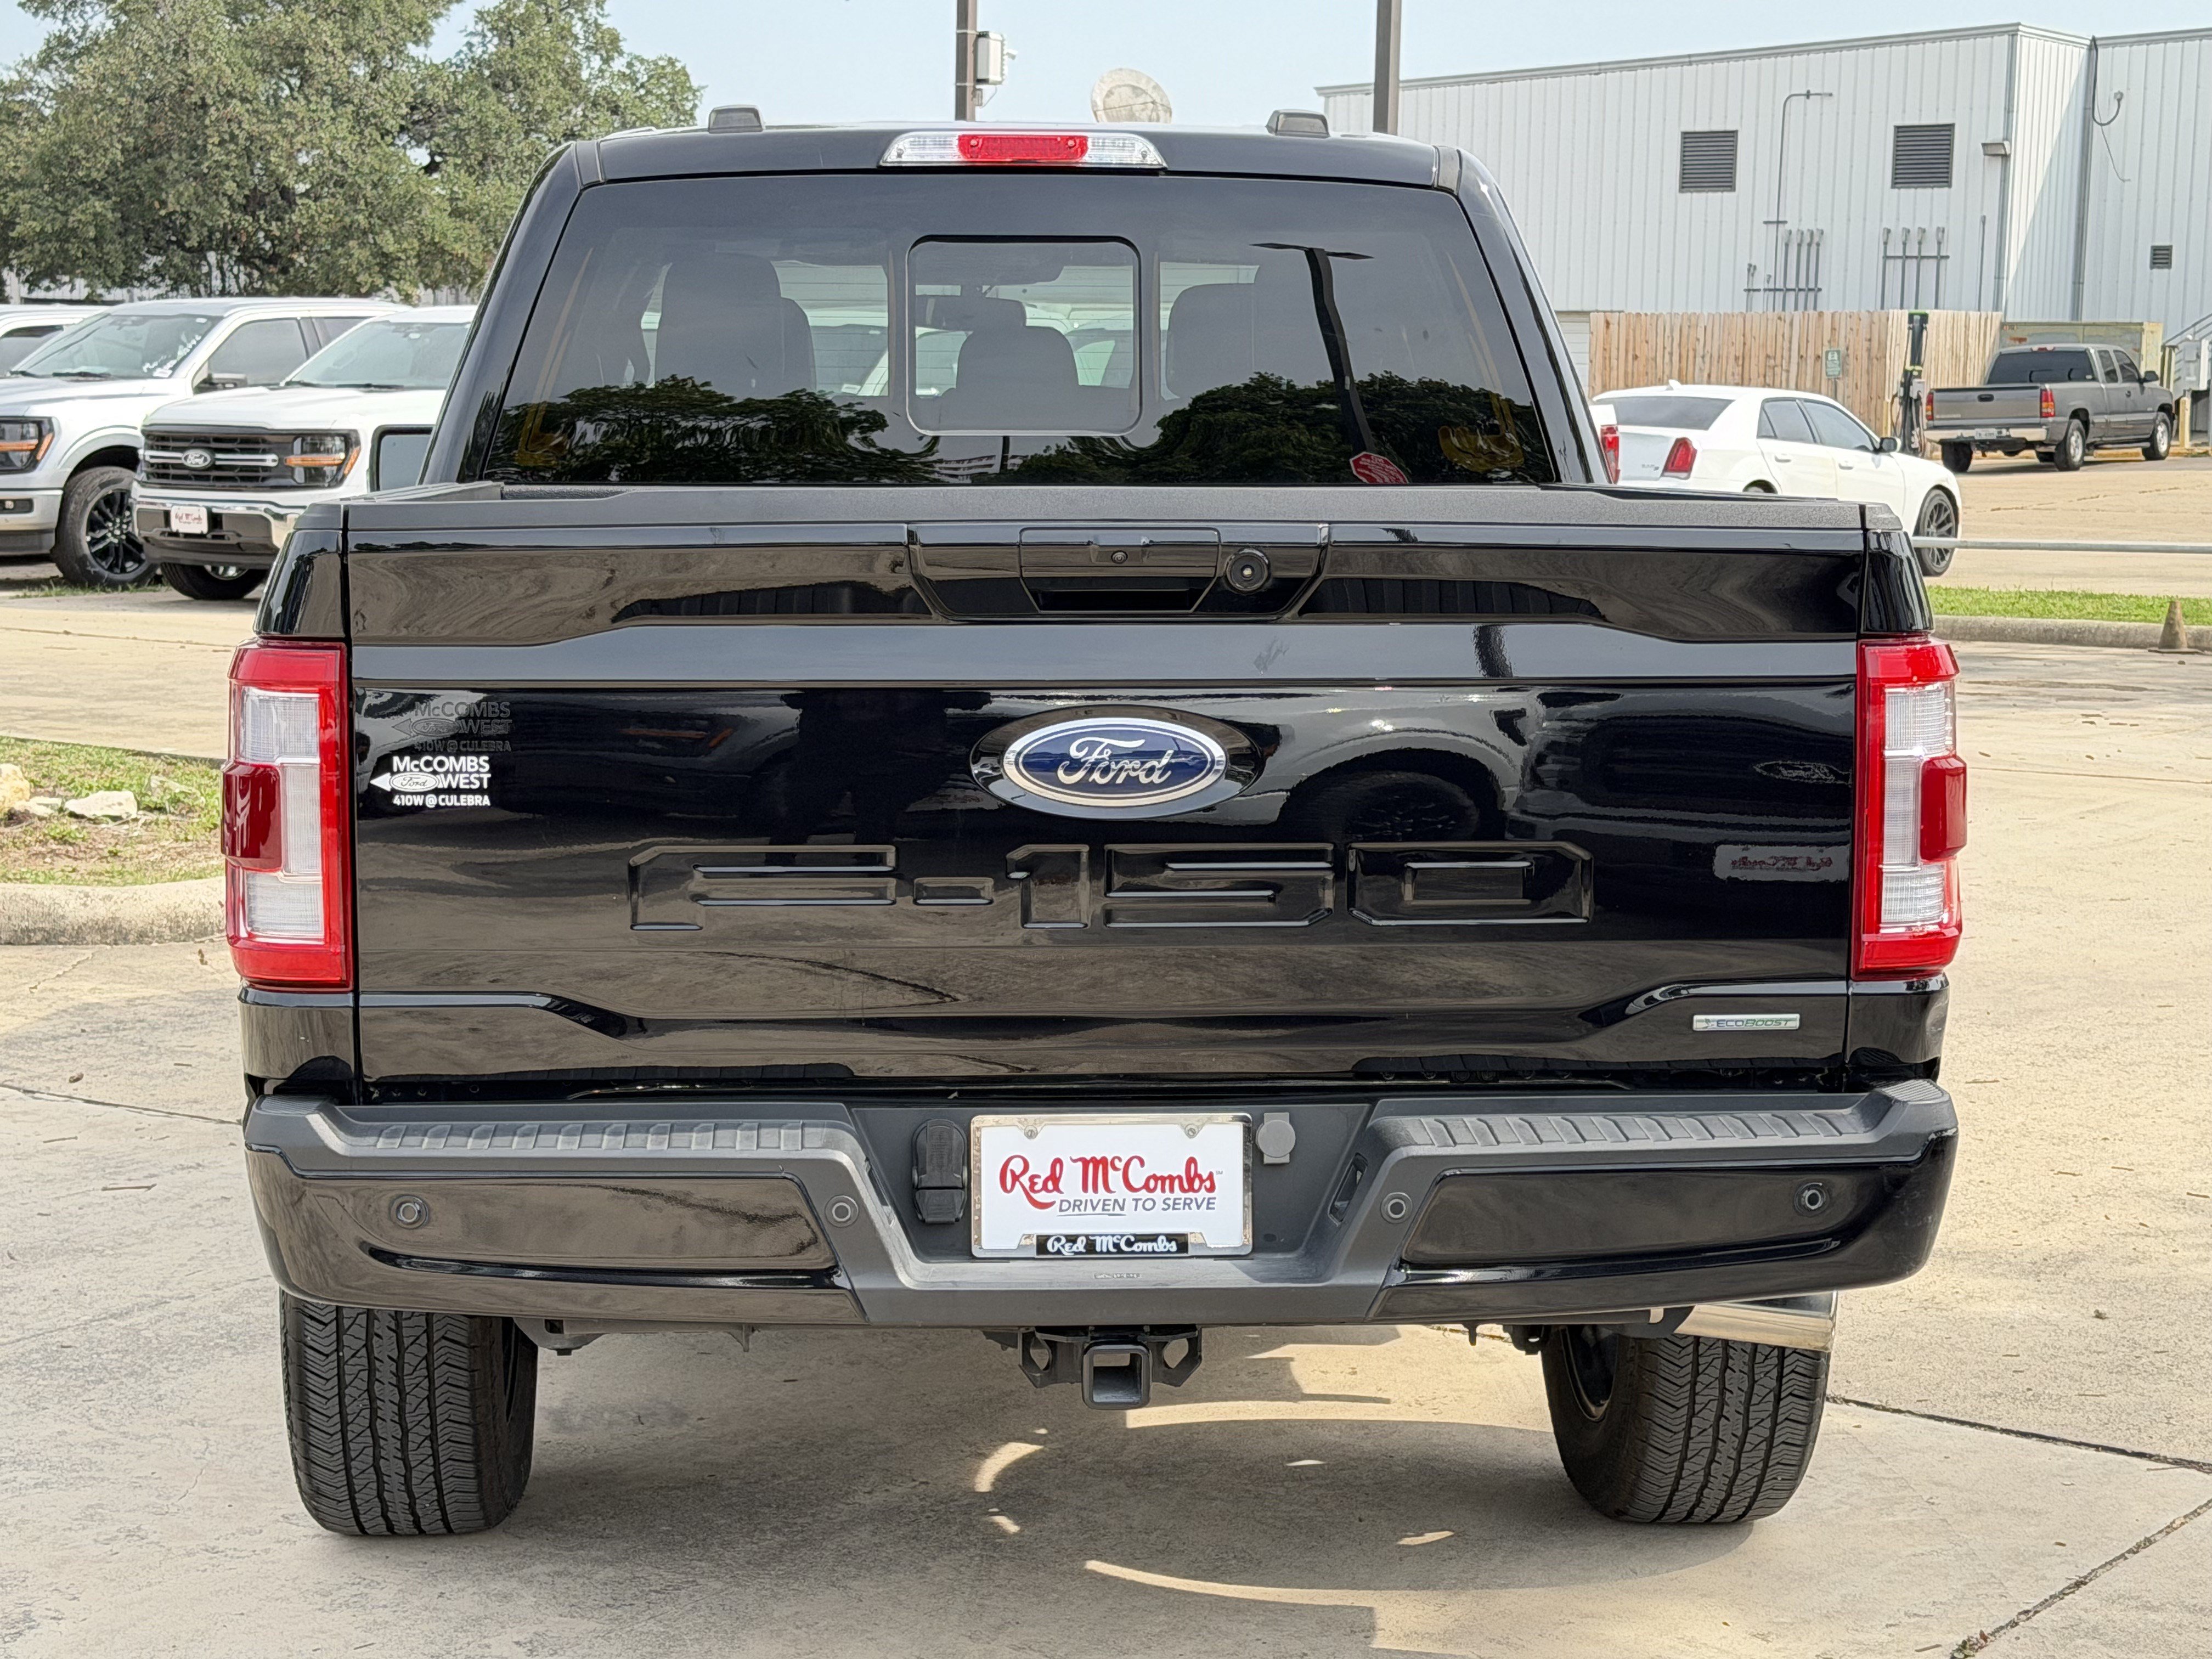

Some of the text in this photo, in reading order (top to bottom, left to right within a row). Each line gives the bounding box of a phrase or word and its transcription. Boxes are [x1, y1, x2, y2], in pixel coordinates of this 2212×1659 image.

[415, 702, 511, 718] McCOMBS
[461, 719, 512, 734] WEST
[460, 740, 512, 752] CULEBRA
[392, 755, 489, 772] McCOMBS
[1057, 736, 1175, 785] Ford
[439, 774, 492, 789] WEST
[438, 795, 491, 806] CULEBRA
[629, 842, 1595, 930] F-150
[1716, 1019, 1790, 1028] ECOBOOST
[999, 1154, 1064, 1210] Red
[1069, 1154, 1217, 1194] McCombs
[1058, 1197, 1217, 1212] DRIVEN TO SERVE
[1047, 1234, 1178, 1256] Red McCombs
